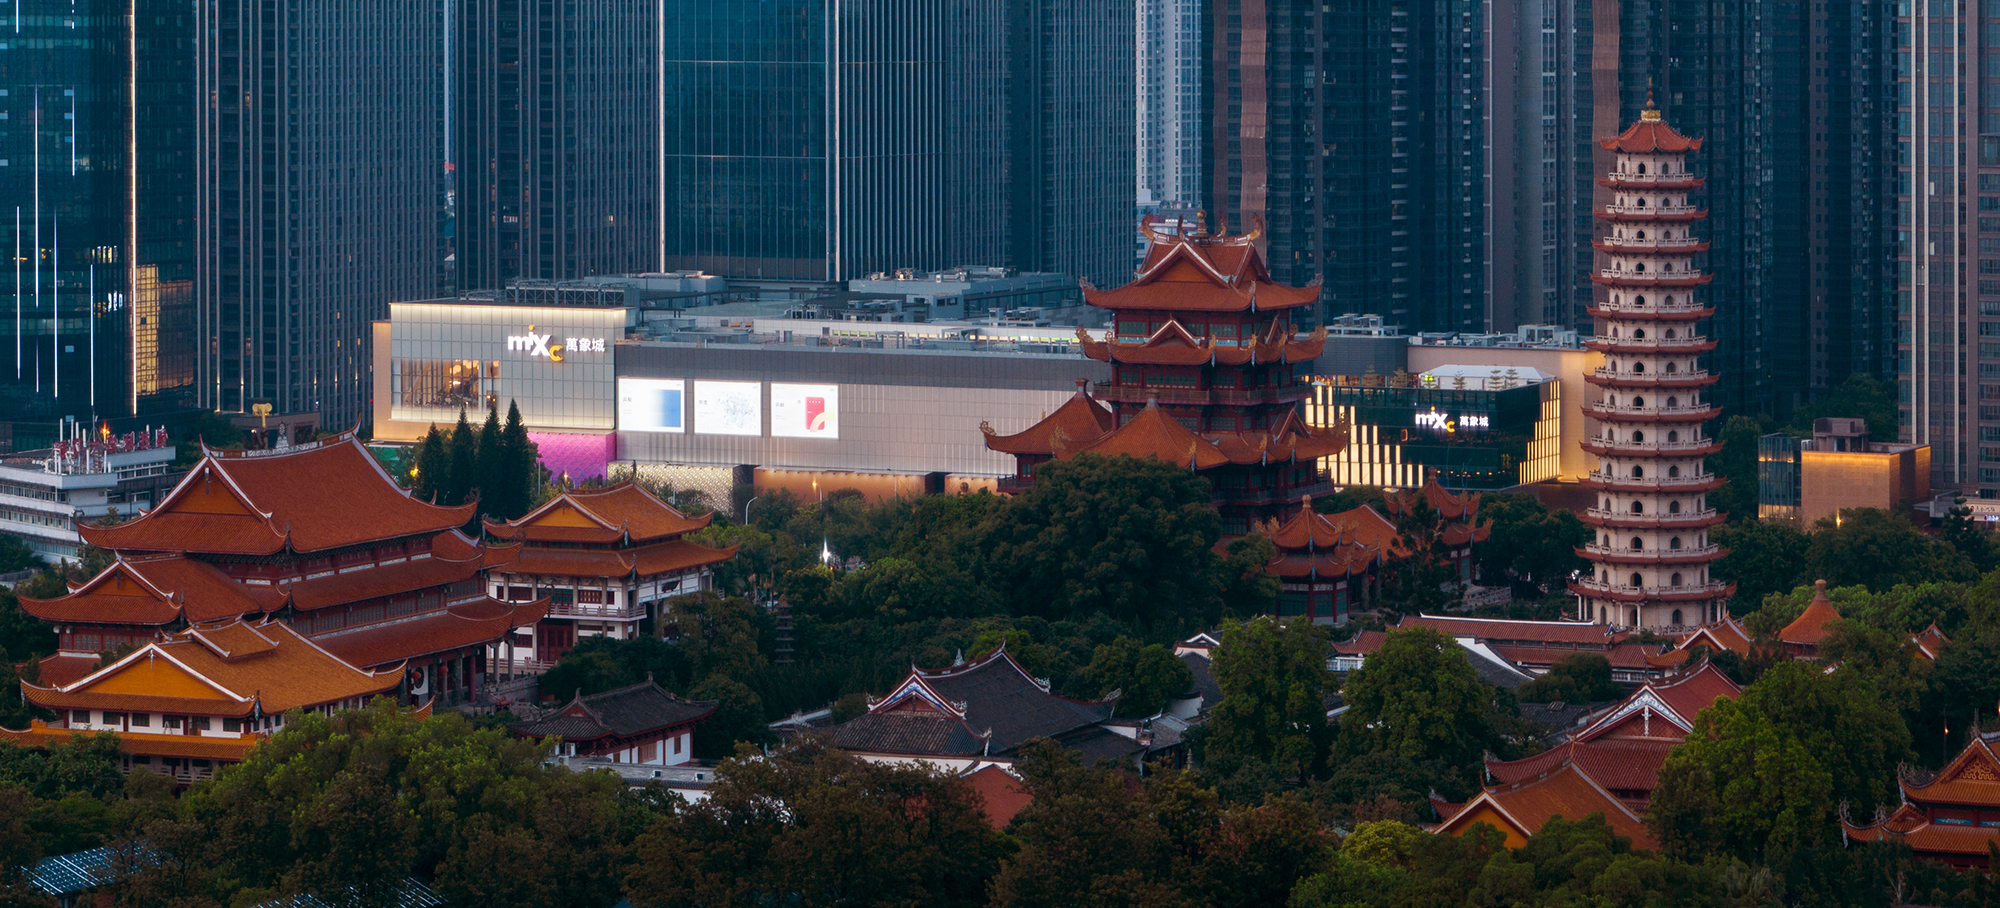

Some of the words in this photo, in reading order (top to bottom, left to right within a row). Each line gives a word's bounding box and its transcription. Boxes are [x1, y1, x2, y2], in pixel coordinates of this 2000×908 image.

[565, 337, 606, 353] 萬象城
[1459, 415, 1489, 427] 萬象城
